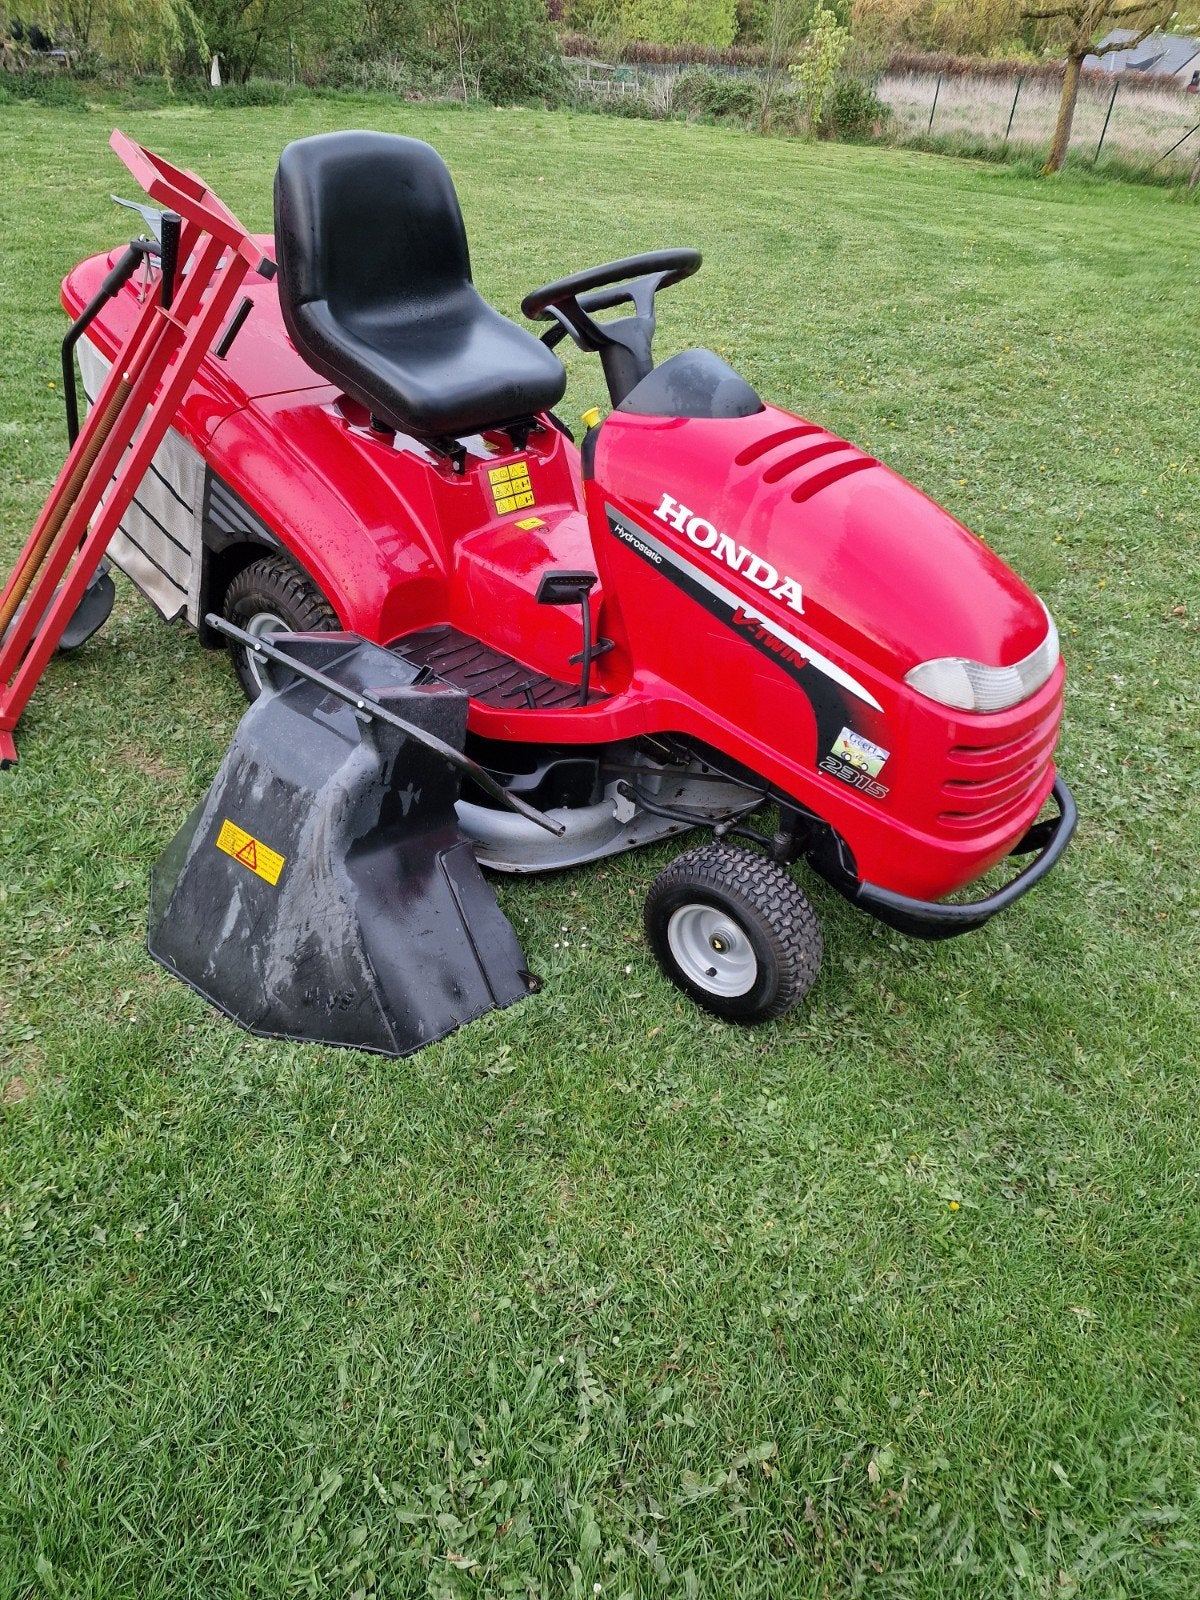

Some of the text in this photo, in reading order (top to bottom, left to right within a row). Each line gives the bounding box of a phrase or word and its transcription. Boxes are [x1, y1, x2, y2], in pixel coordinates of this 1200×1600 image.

[614, 524, 663, 564] Hydrostatic
[653, 492, 806, 615] HONDA
[730, 606, 810, 670] V-TWIN
[819, 755, 890, 799] 2315
